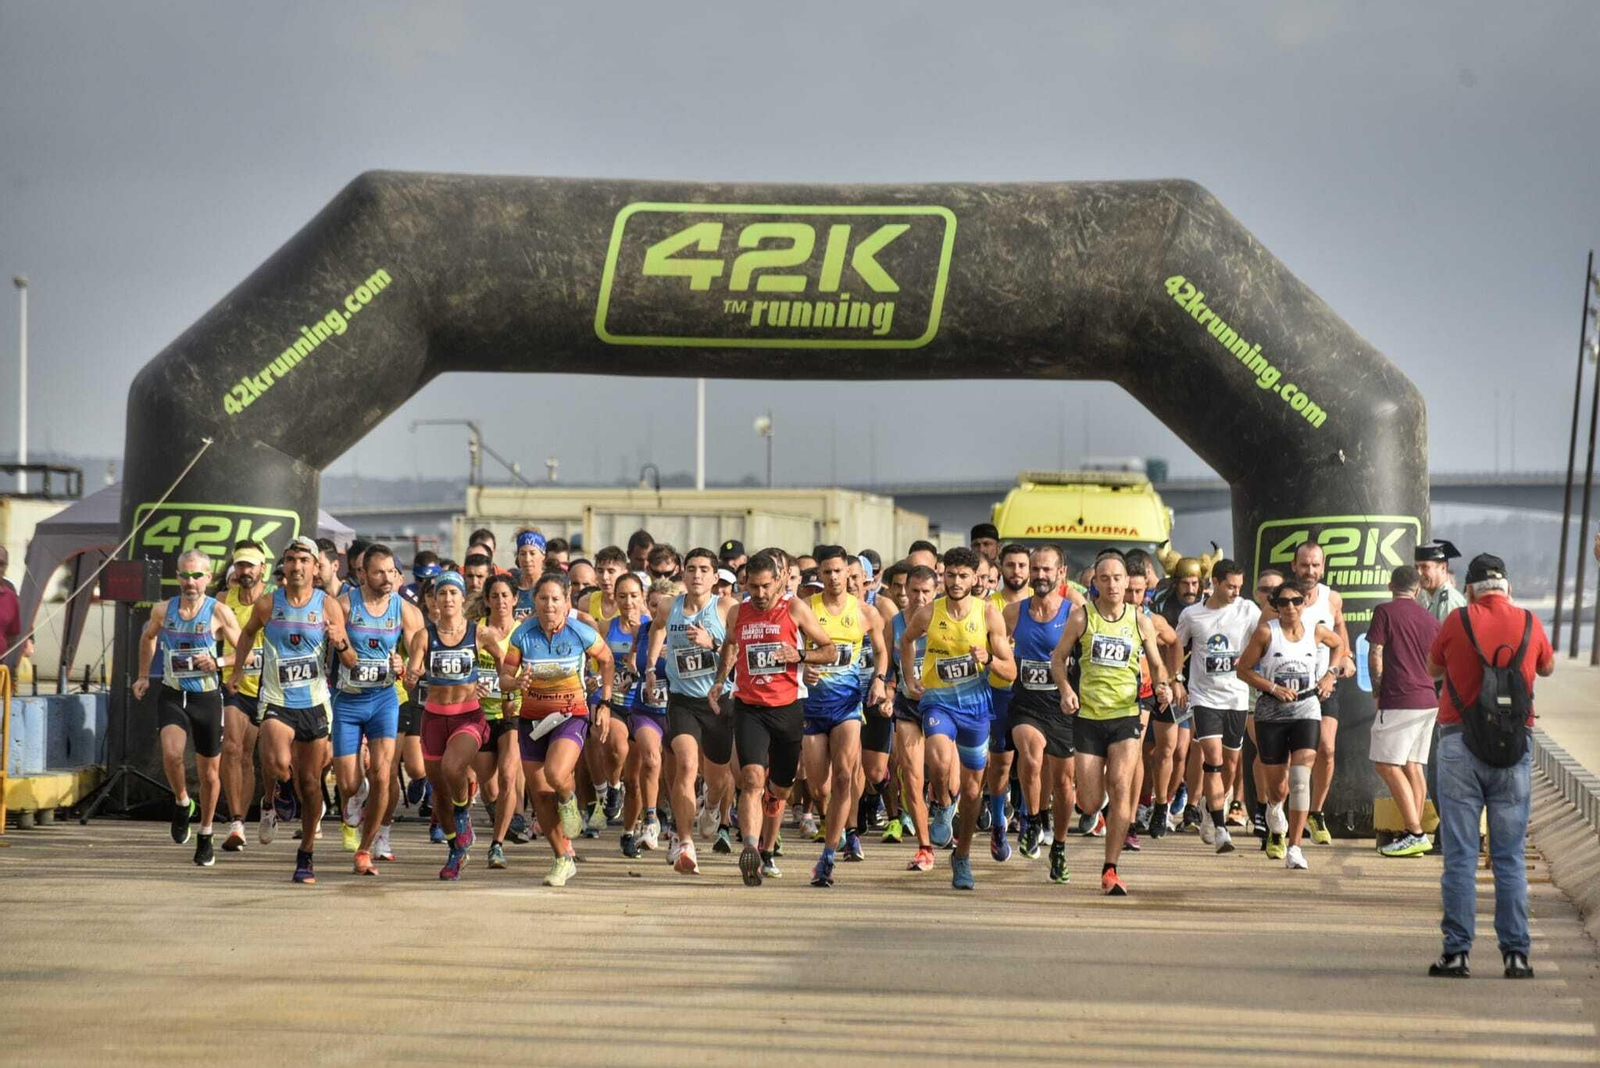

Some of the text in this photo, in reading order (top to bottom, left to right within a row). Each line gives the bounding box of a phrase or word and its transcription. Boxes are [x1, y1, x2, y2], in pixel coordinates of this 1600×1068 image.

[642, 222, 911, 293] 42K
[723, 293, 895, 336] TM running
[223, 268, 393, 416] 42krunning.com
[1164, 275, 1328, 429] 42krunning.com
[142, 515, 283, 559] 42K
[1270, 527, 1407, 567] 42K
[1326, 566, 1391, 586] runnin
[765, 627, 781, 635] CIVIL
[756, 651, 776, 668] 84
[1099, 643, 1125, 661] 128
[441, 658, 462, 674] 56
[685, 654, 703, 671] 67
[944, 662, 969, 679] 157
[1215, 657, 1232, 672] 28
[285, 664, 312, 681] 124
[359, 666, 379, 681] 36
[1029, 669, 1048, 684] 23
